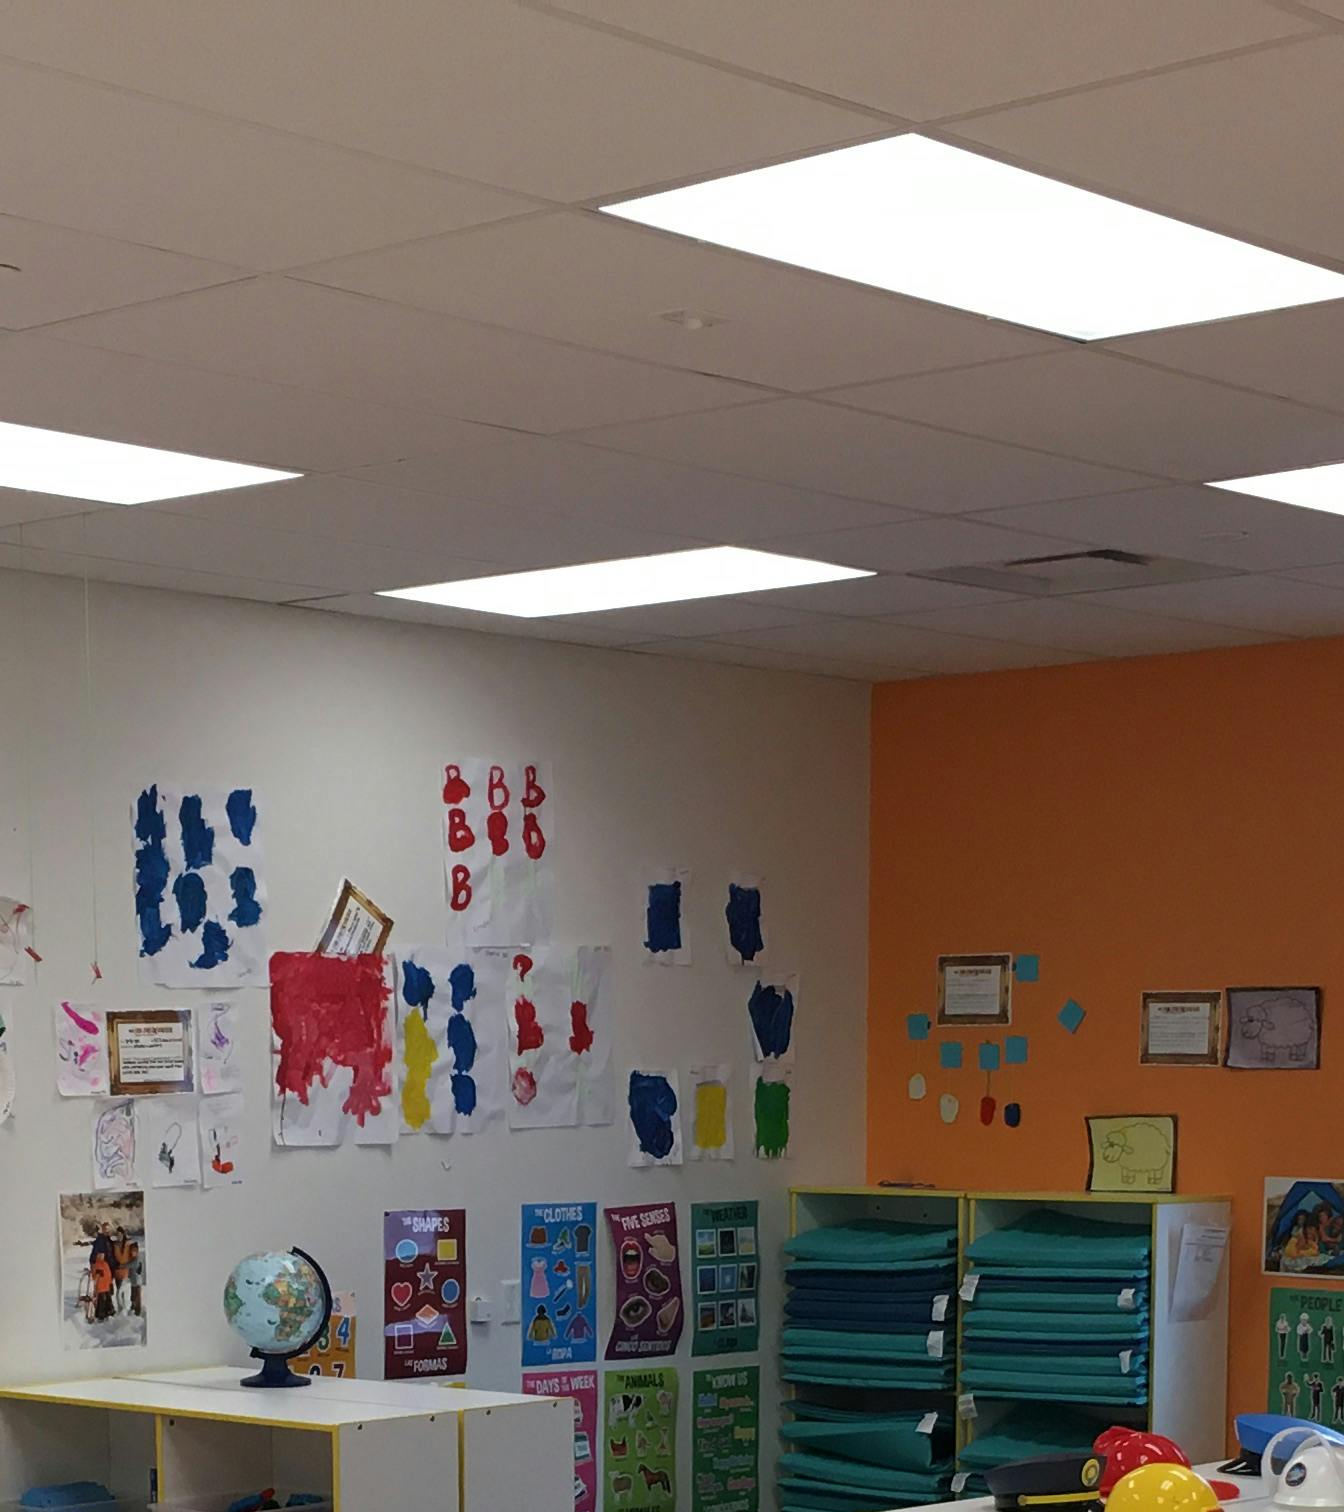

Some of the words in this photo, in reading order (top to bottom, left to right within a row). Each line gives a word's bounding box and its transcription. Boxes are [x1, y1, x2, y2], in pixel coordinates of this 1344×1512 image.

[450, 864, 472, 911] B
[544, 1206, 584, 1224] CLOTHES
[621, 1215, 641, 1232] FIVE
[640, 1207, 671, 1228] SENSES
[412, 1217, 451, 1233] SHAPES
[1300, 1296, 1342, 1312] PEOPLE
[337, 1315, 350, 1346] 4
[413, 1357, 448, 1374] FORMAS
[536, 1377, 560, 1395] DAYS
[570, 1375, 596, 1391] WEEK
[624, 1372, 665, 1390] ANIMALS
